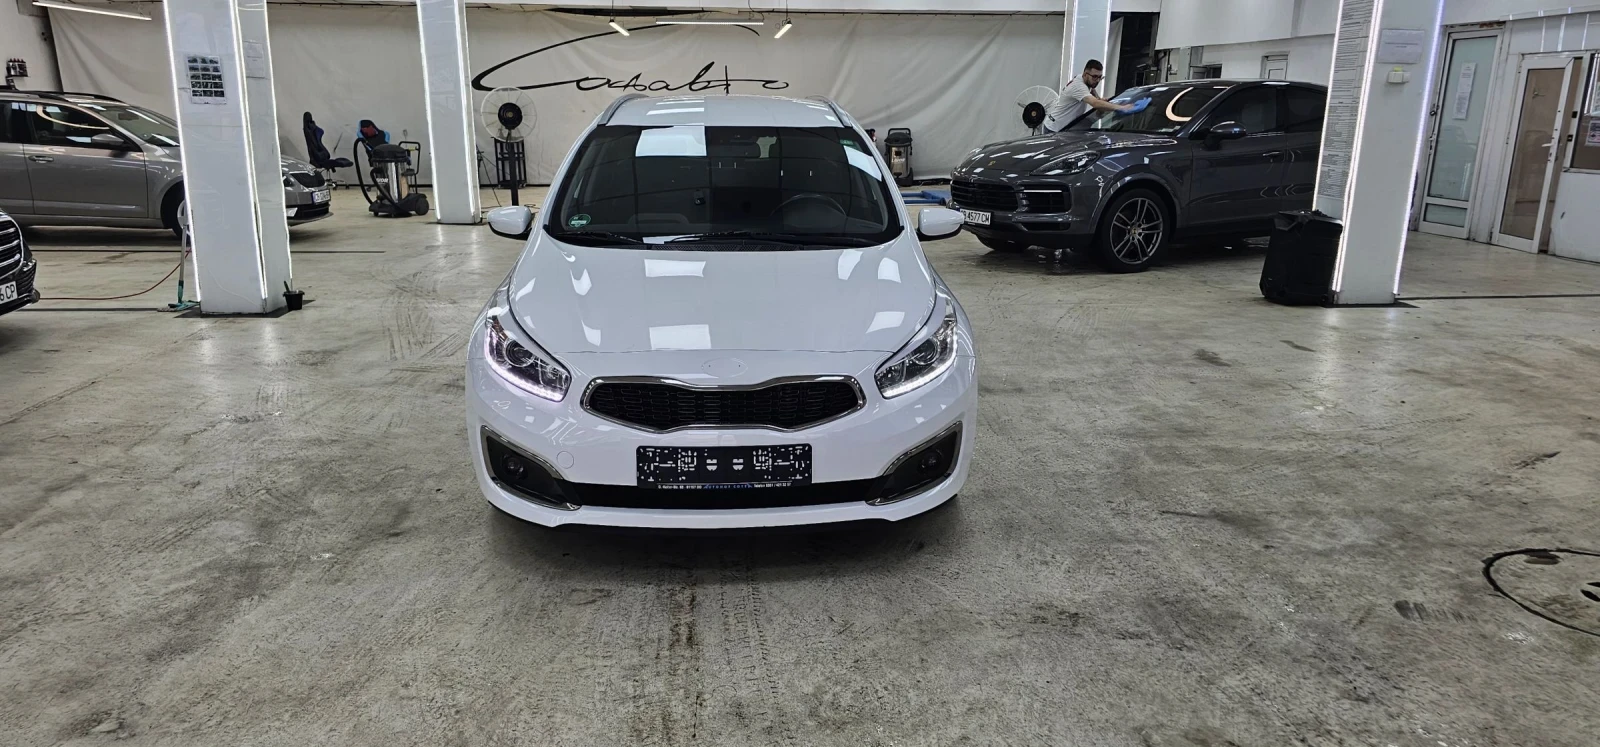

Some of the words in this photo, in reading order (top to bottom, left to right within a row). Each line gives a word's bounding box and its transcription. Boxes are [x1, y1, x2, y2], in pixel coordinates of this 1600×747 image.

[967, 211, 981, 222] 4577
[981, 213, 990, 223] CM
[5, 284, 15, 299] CP
